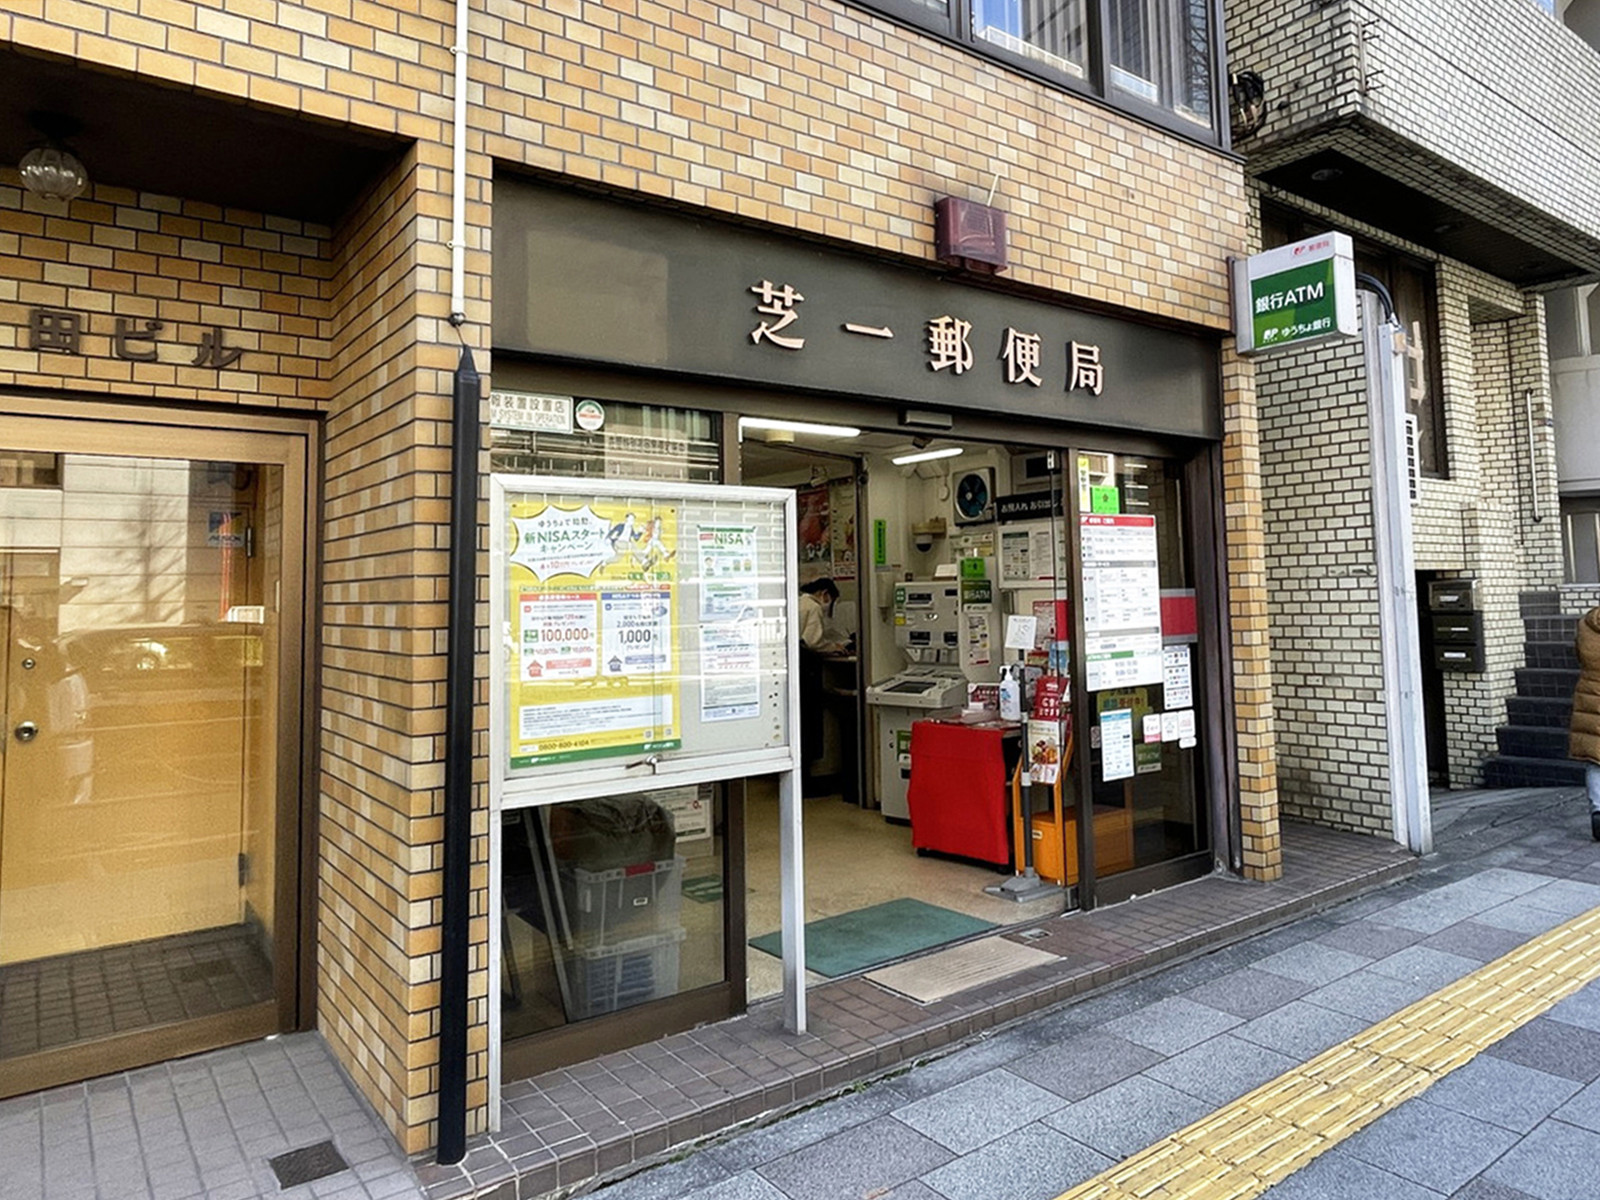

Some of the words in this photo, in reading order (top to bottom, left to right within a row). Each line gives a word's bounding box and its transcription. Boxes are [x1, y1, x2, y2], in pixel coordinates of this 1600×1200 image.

[1255, 281, 1324, 314] 銀行ATM
[29, 308, 242, 369] 田ビル
[750, 279, 1104, 396] 芝一郵便局
[1281, 316, 1331, 338] ゆうちょ銀行
[524, 528, 606, 545] 新NISAスタート
[540, 541, 594, 554] キャンペーン
